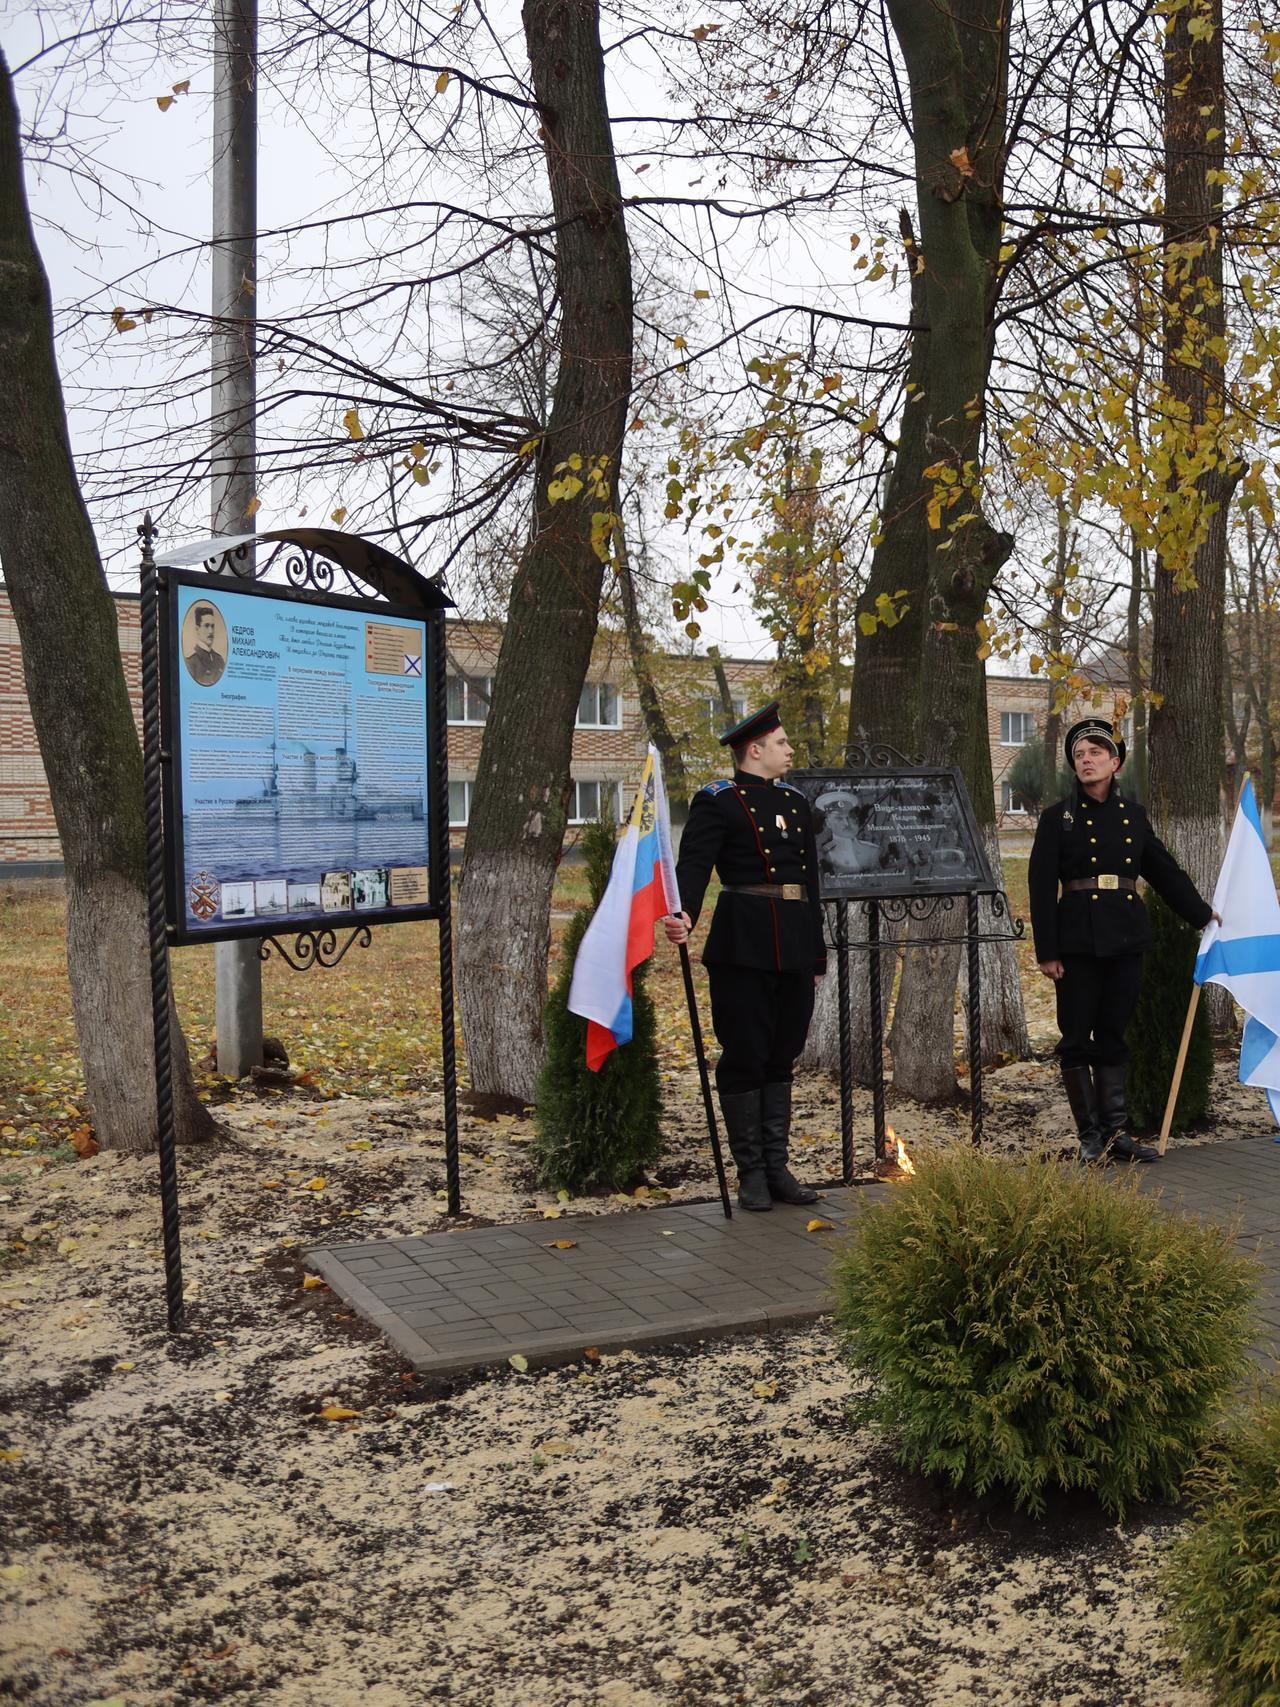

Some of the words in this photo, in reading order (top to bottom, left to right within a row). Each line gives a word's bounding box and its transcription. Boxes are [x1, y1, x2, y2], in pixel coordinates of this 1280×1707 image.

[231, 625, 255, 636] КЕДРОВ
[231, 636, 256, 647] МИХАИЛ
[232, 647, 281, 660] АЛЕКСАНДРОВИЧ
[873, 803, 931, 813] Вице-адмирал
